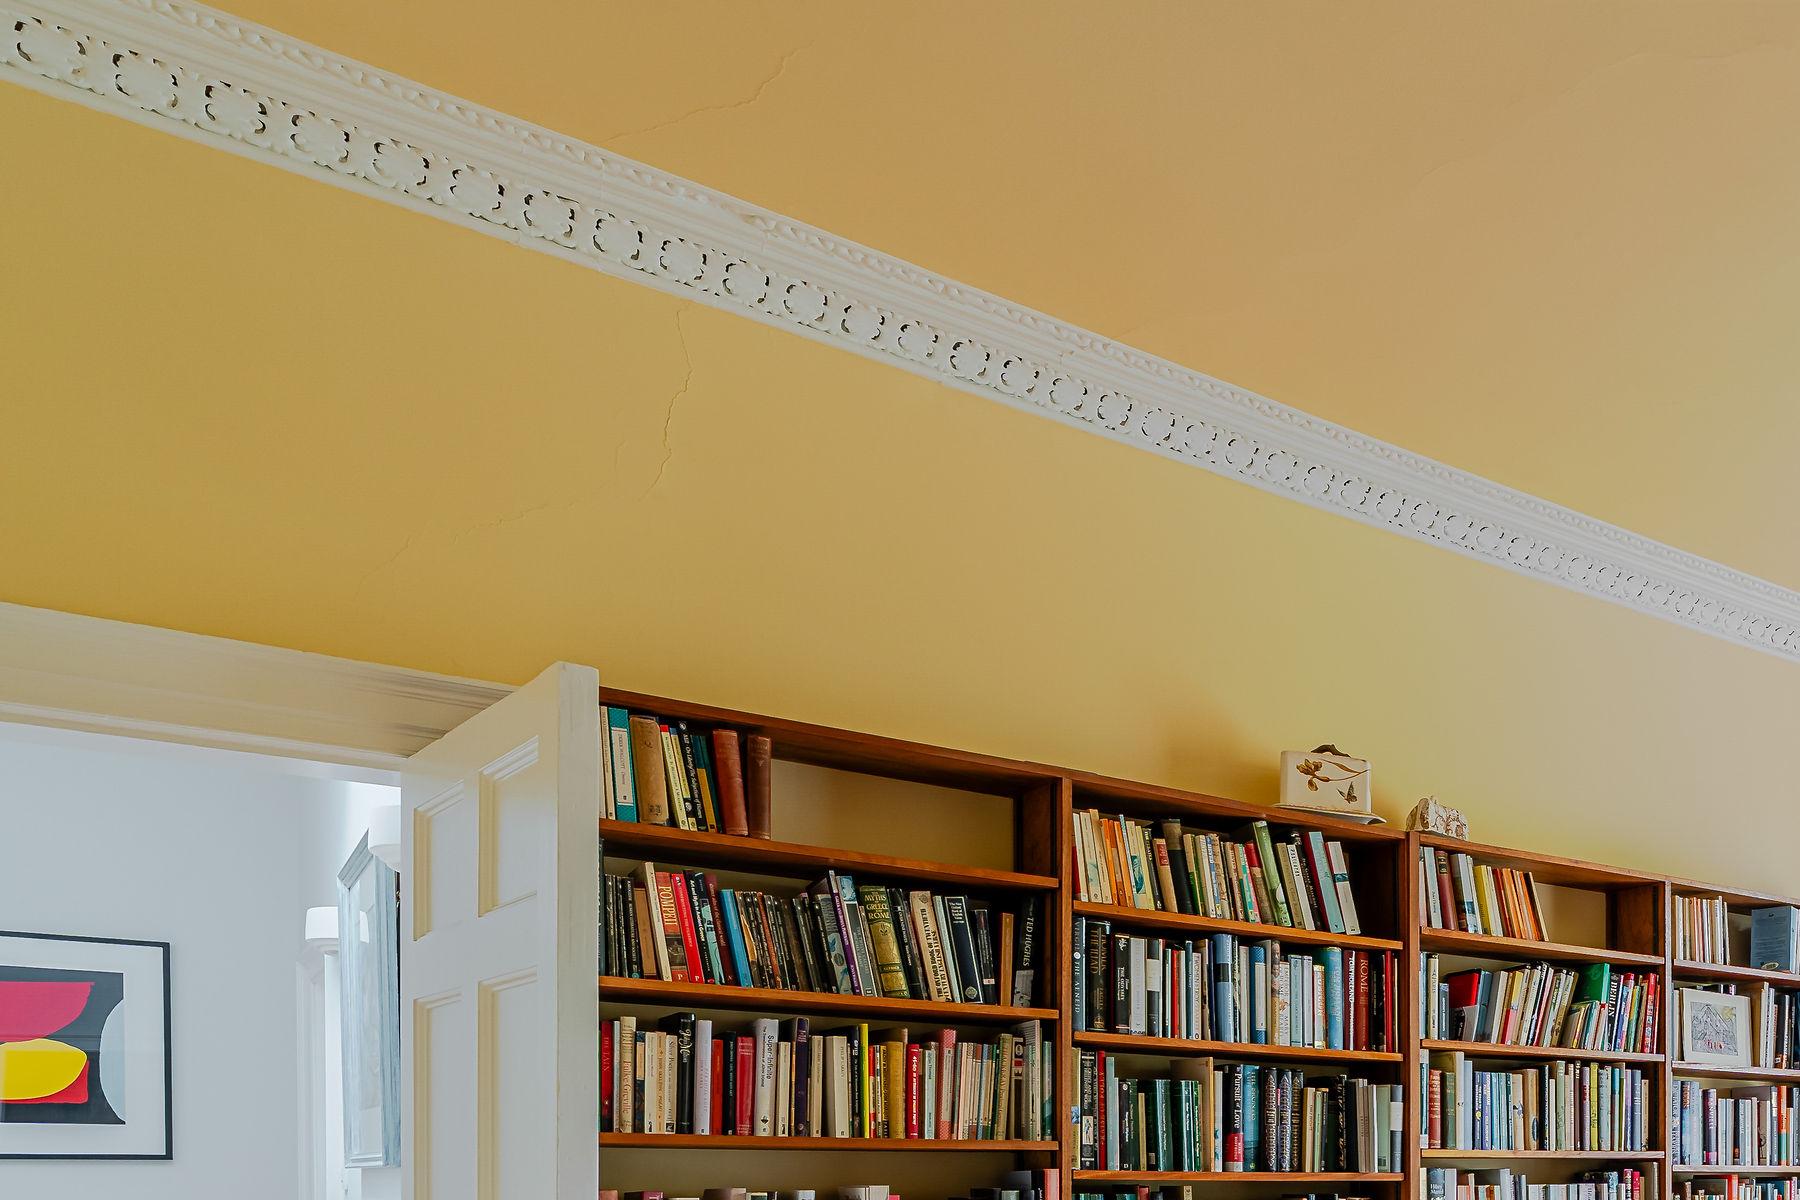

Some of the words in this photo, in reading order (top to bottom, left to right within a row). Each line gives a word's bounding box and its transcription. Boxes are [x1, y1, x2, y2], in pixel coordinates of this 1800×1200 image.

[658, 886, 678, 926] POMPEII
[868, 911, 890, 919] ROME
[920, 908, 932, 941] TWENTIETH
[1026, 917, 1034, 932] TED
[931, 930, 940, 948] VERSE
[1022, 934, 1033, 967] HUGHES
[1089, 929, 1099, 948] THE
[929, 949, 937, 964] BOOK
[935, 949, 945, 972] ENGLISH
[1089, 948, 1099, 975] ILIAD
[931, 965, 941, 987] OXFORD
[1360, 959, 1369, 993] ROME
[1608, 981, 1618, 1017] BERLIN
[766, 1035, 775, 1080] Super-Infinite
[623, 1060, 632, 1083] Fulke
[623, 1084, 632, 1114] Greville
[1234, 1073, 1242, 1102] Pursuit
[1234, 1109, 1242, 1129] Love
